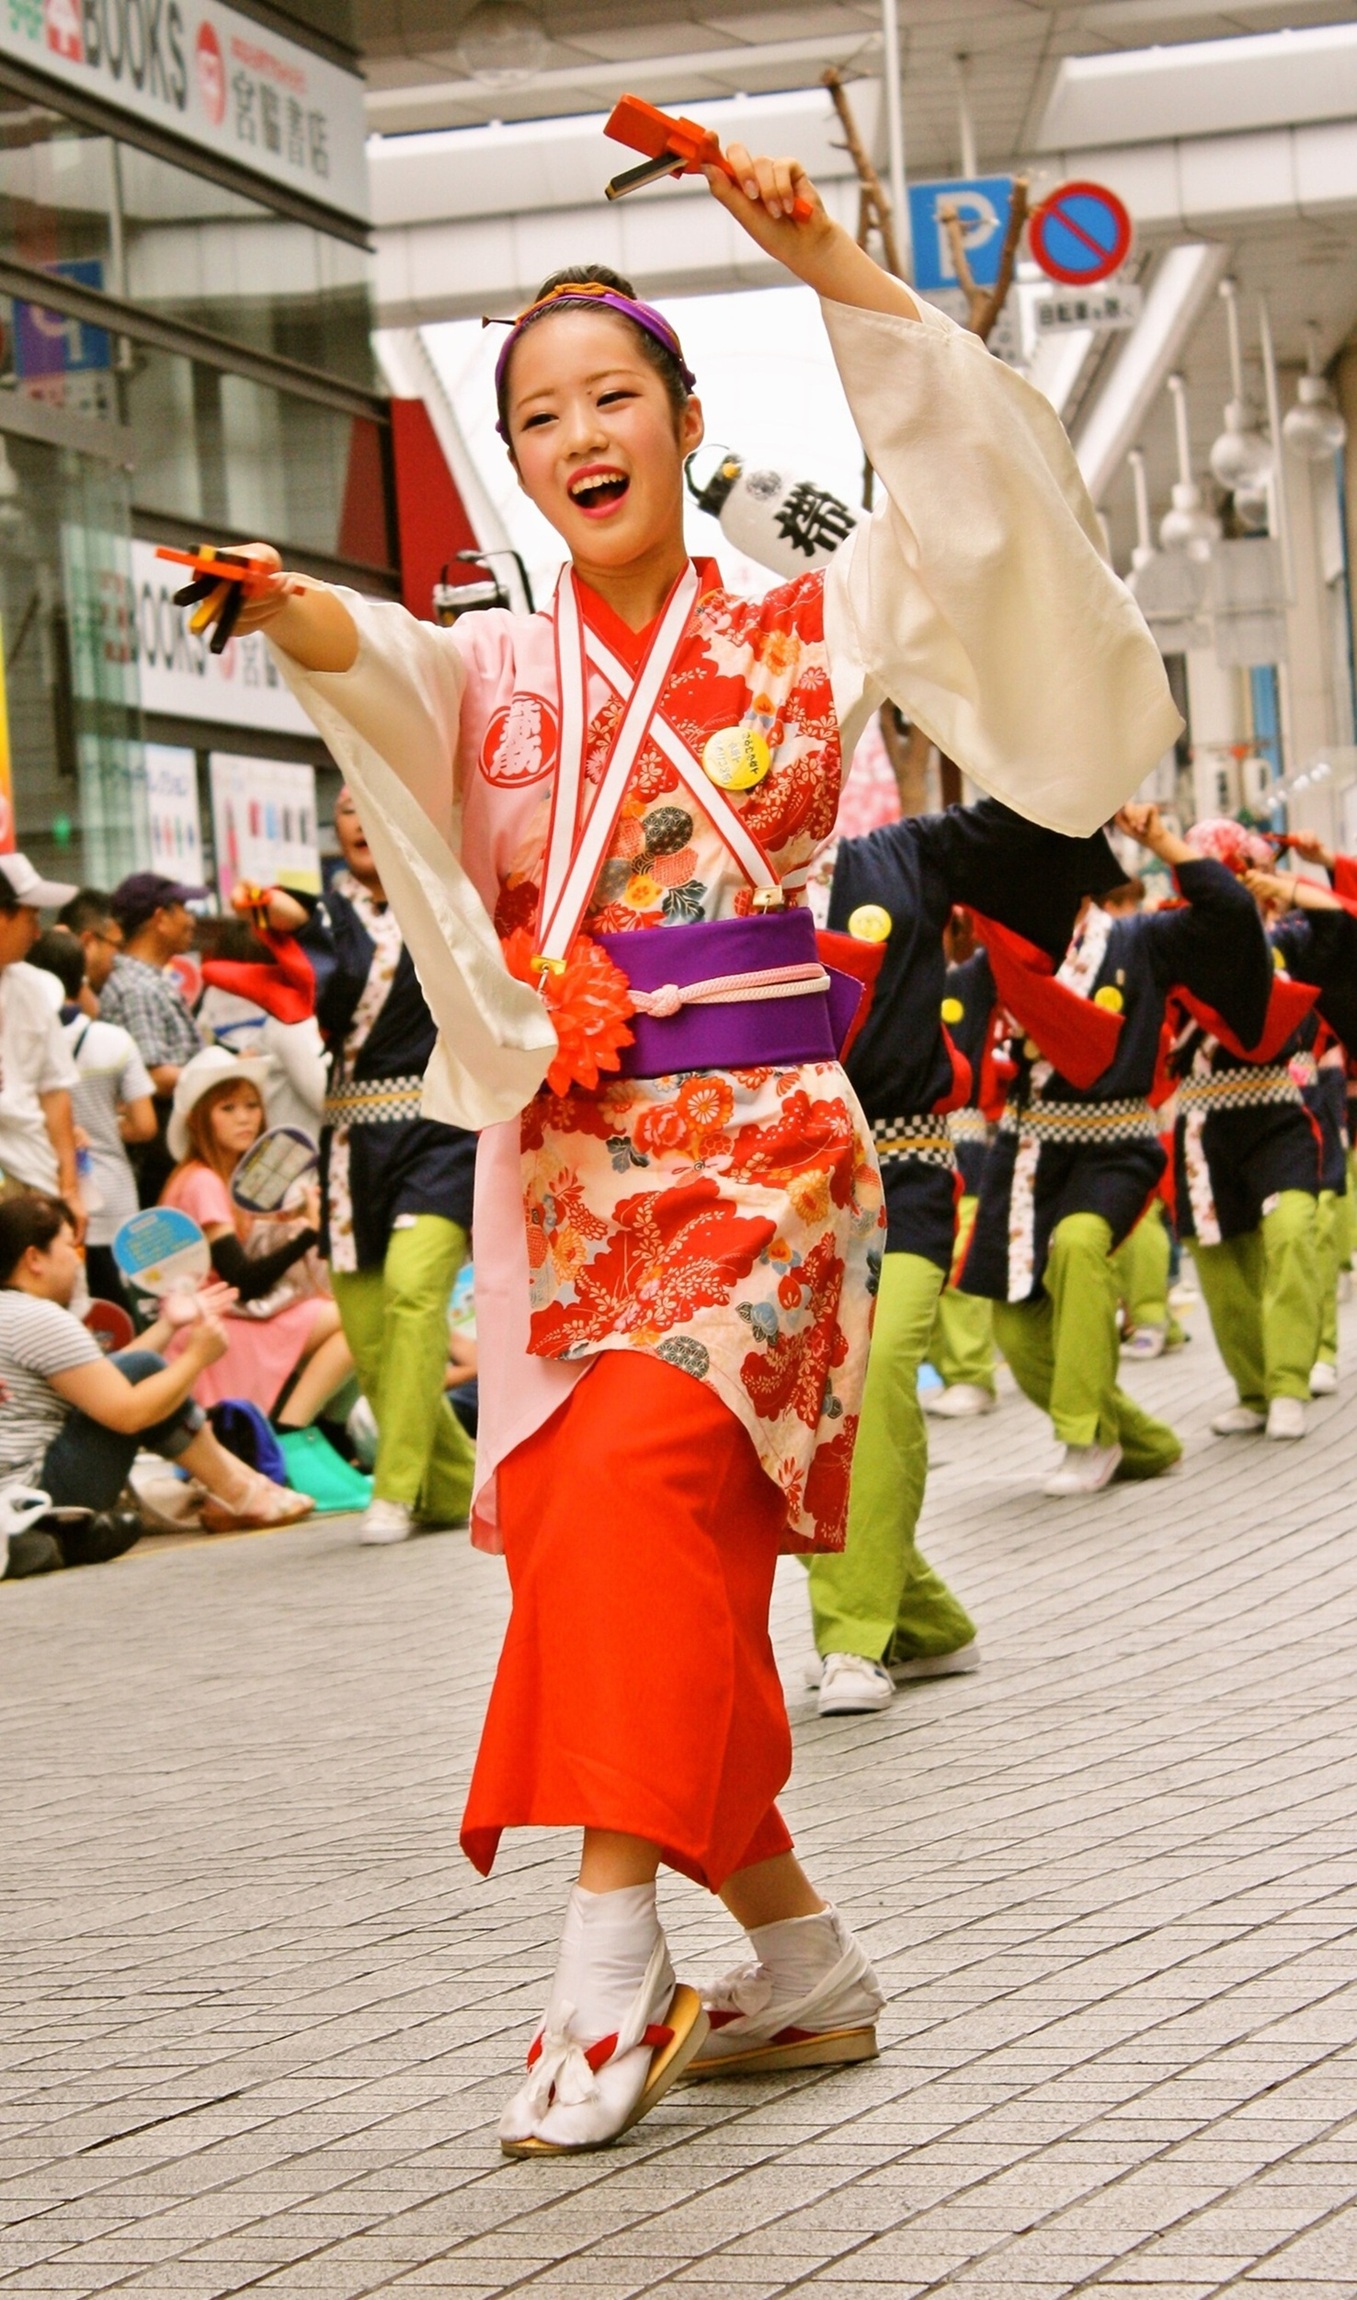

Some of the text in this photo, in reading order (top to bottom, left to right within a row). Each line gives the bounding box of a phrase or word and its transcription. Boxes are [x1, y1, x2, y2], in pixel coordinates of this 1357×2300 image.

[83, 0, 187, 112] BOOKS
[936, 191, 998, 280] P
[773, 481, 857, 557] 祭
